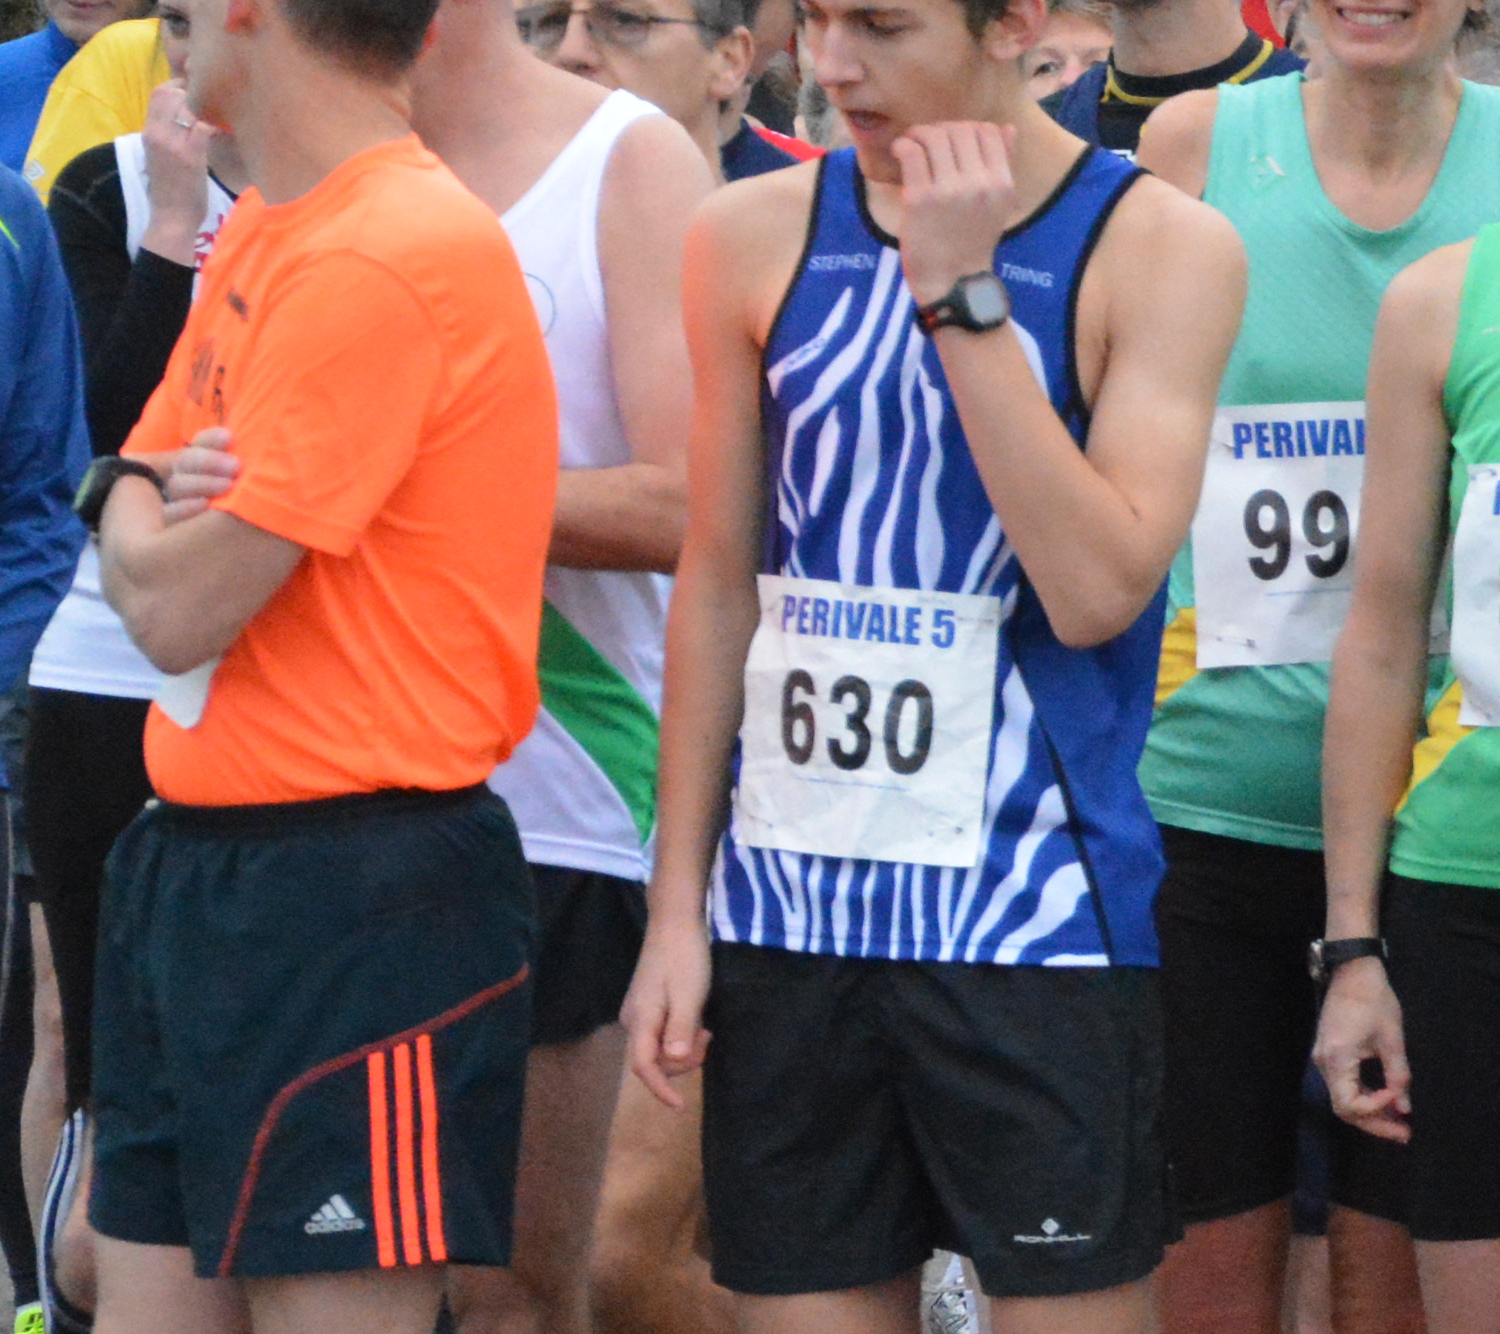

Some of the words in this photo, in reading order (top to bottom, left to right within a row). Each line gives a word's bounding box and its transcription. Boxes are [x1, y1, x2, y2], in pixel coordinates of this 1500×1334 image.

[781, 594, 922, 646] PERIVALE
[931, 609, 956, 649] 5
[780, 667, 935, 776] 630
